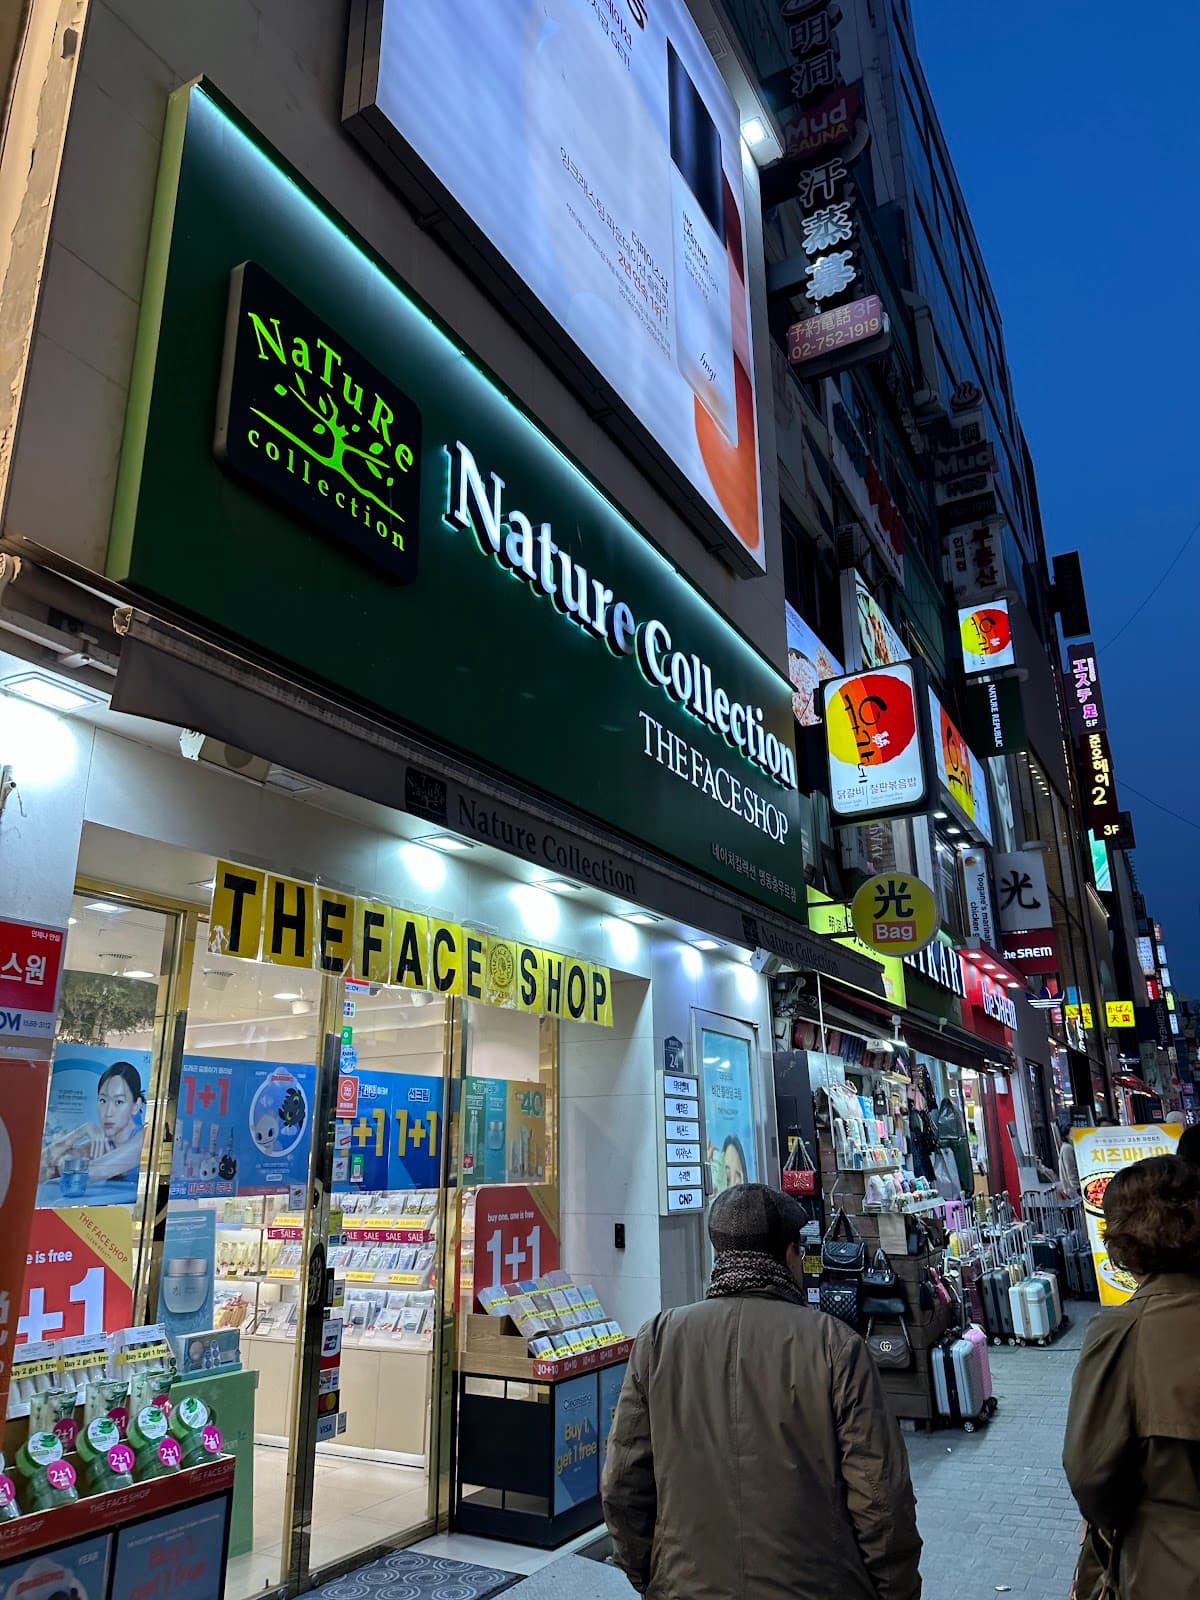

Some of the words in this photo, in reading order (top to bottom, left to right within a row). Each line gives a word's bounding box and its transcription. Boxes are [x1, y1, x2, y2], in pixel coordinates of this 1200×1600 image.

[785, 99, 847, 147] Mud
[787, 124, 849, 158] SAUNA
[560, 147, 605, 222] 잉크래스팅
[606, 214, 648, 277] 파운데이션
[798, 157, 856, 300] 汗蒸幕
[854, 301, 877, 320] 3F
[791, 318, 880, 360] 02-752-1919
[247, 427, 406, 553] collection
[452, 440, 635, 656] Nature
[638, 620, 797, 791] Collection
[988, 684, 1000, 713] NATURE
[992, 712, 1003, 748] REPUBLIC
[1085, 719, 1098, 728] 5F
[638, 710, 689, 781] THE
[690, 747, 743, 817] FACE
[744, 786, 789, 846] SHOP
[836, 786, 865, 800] 닭갈비
[1092, 786, 1107, 806] 2
[1104, 824, 1119, 836] 3F
[457, 793, 537, 856] Nature
[542, 834, 638, 897] Collection
[873, 879, 914, 920] 光
[976, 872, 989, 911] Yoogane's
[1001, 870, 1041, 911] 光
[970, 901, 980, 930] chicken
[875, 925, 914, 942] Bag
[223, 872, 347, 973] THE
[361, 909, 483, 1001] FACE
[520, 947, 608, 1022] SHOP
[1003, 950, 1017, 961] the
[1018, 946, 1053, 958] SAEM
[903, 940, 968, 999] IKARI
[669, 1054, 679, 1068] 24
[184, 1076, 230, 1117] 1+1
[408, 1088, 430, 1102] 선크림
[395, 1108, 438, 1157] 1+1
[678, 1194, 693, 1206] CNP
[487, 1213, 497, 1223] buy
[79, 1213, 93, 1229] THE
[91, 1226, 110, 1249] FACE
[108, 1243, 129, 1264] SHOP
[281, 1230, 296, 1239] SALE
[363, 1232, 379, 1241] SALE
[386, 1233, 401, 1242] SALE
[407, 1233, 423, 1242] SALE
[35, 1250, 46, 1264] is
[47, 1249, 73, 1263] free
[486, 1225, 541, 1288] 1+1
[28, 1365, 39, 1376] get
[64, 1360, 75, 1371] Buy
[82, 1358, 92, 1368] get
[203, 1432, 220, 1445] 2+1
[319, 1423, 332, 1435] VISA
[565, 1423, 583, 1441] Buy
[110, 1451, 131, 1464] 2+1
[160, 1447, 180, 1459] 2+1
[556, 1448, 572, 1475] get
[578, 1441, 598, 1460] free
[50, 1466, 73, 1480] 2+1
[106, 1495, 130, 1510] FACE
[18, 1519, 44, 1536] SHOP
